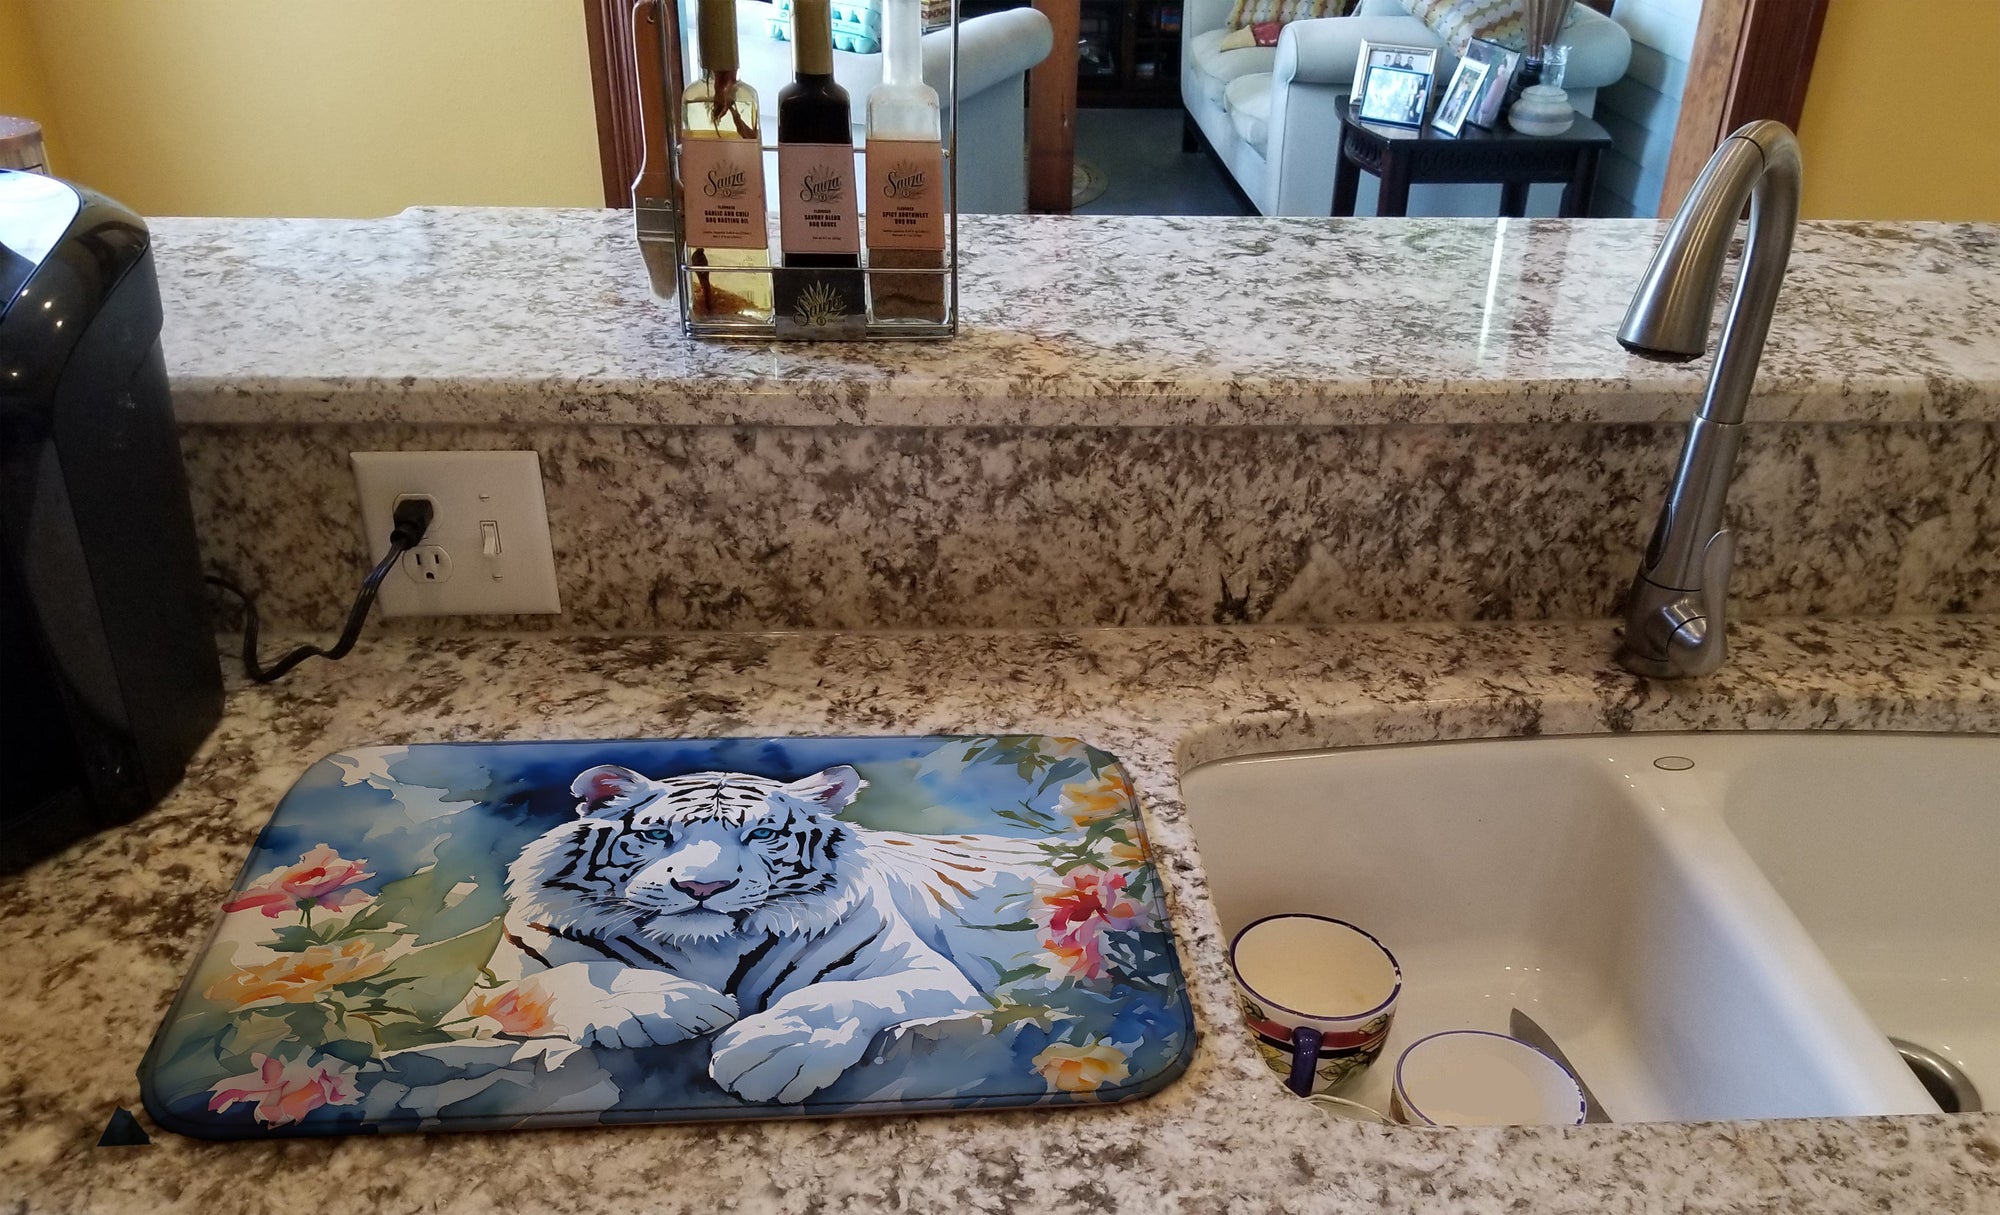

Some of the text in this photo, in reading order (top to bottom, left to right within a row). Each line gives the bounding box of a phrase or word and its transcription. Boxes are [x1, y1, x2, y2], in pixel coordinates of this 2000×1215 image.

[704, 170, 745, 197] Sauza
[800, 176, 841, 202] Sauza
[884, 171, 924, 198] Sauza
